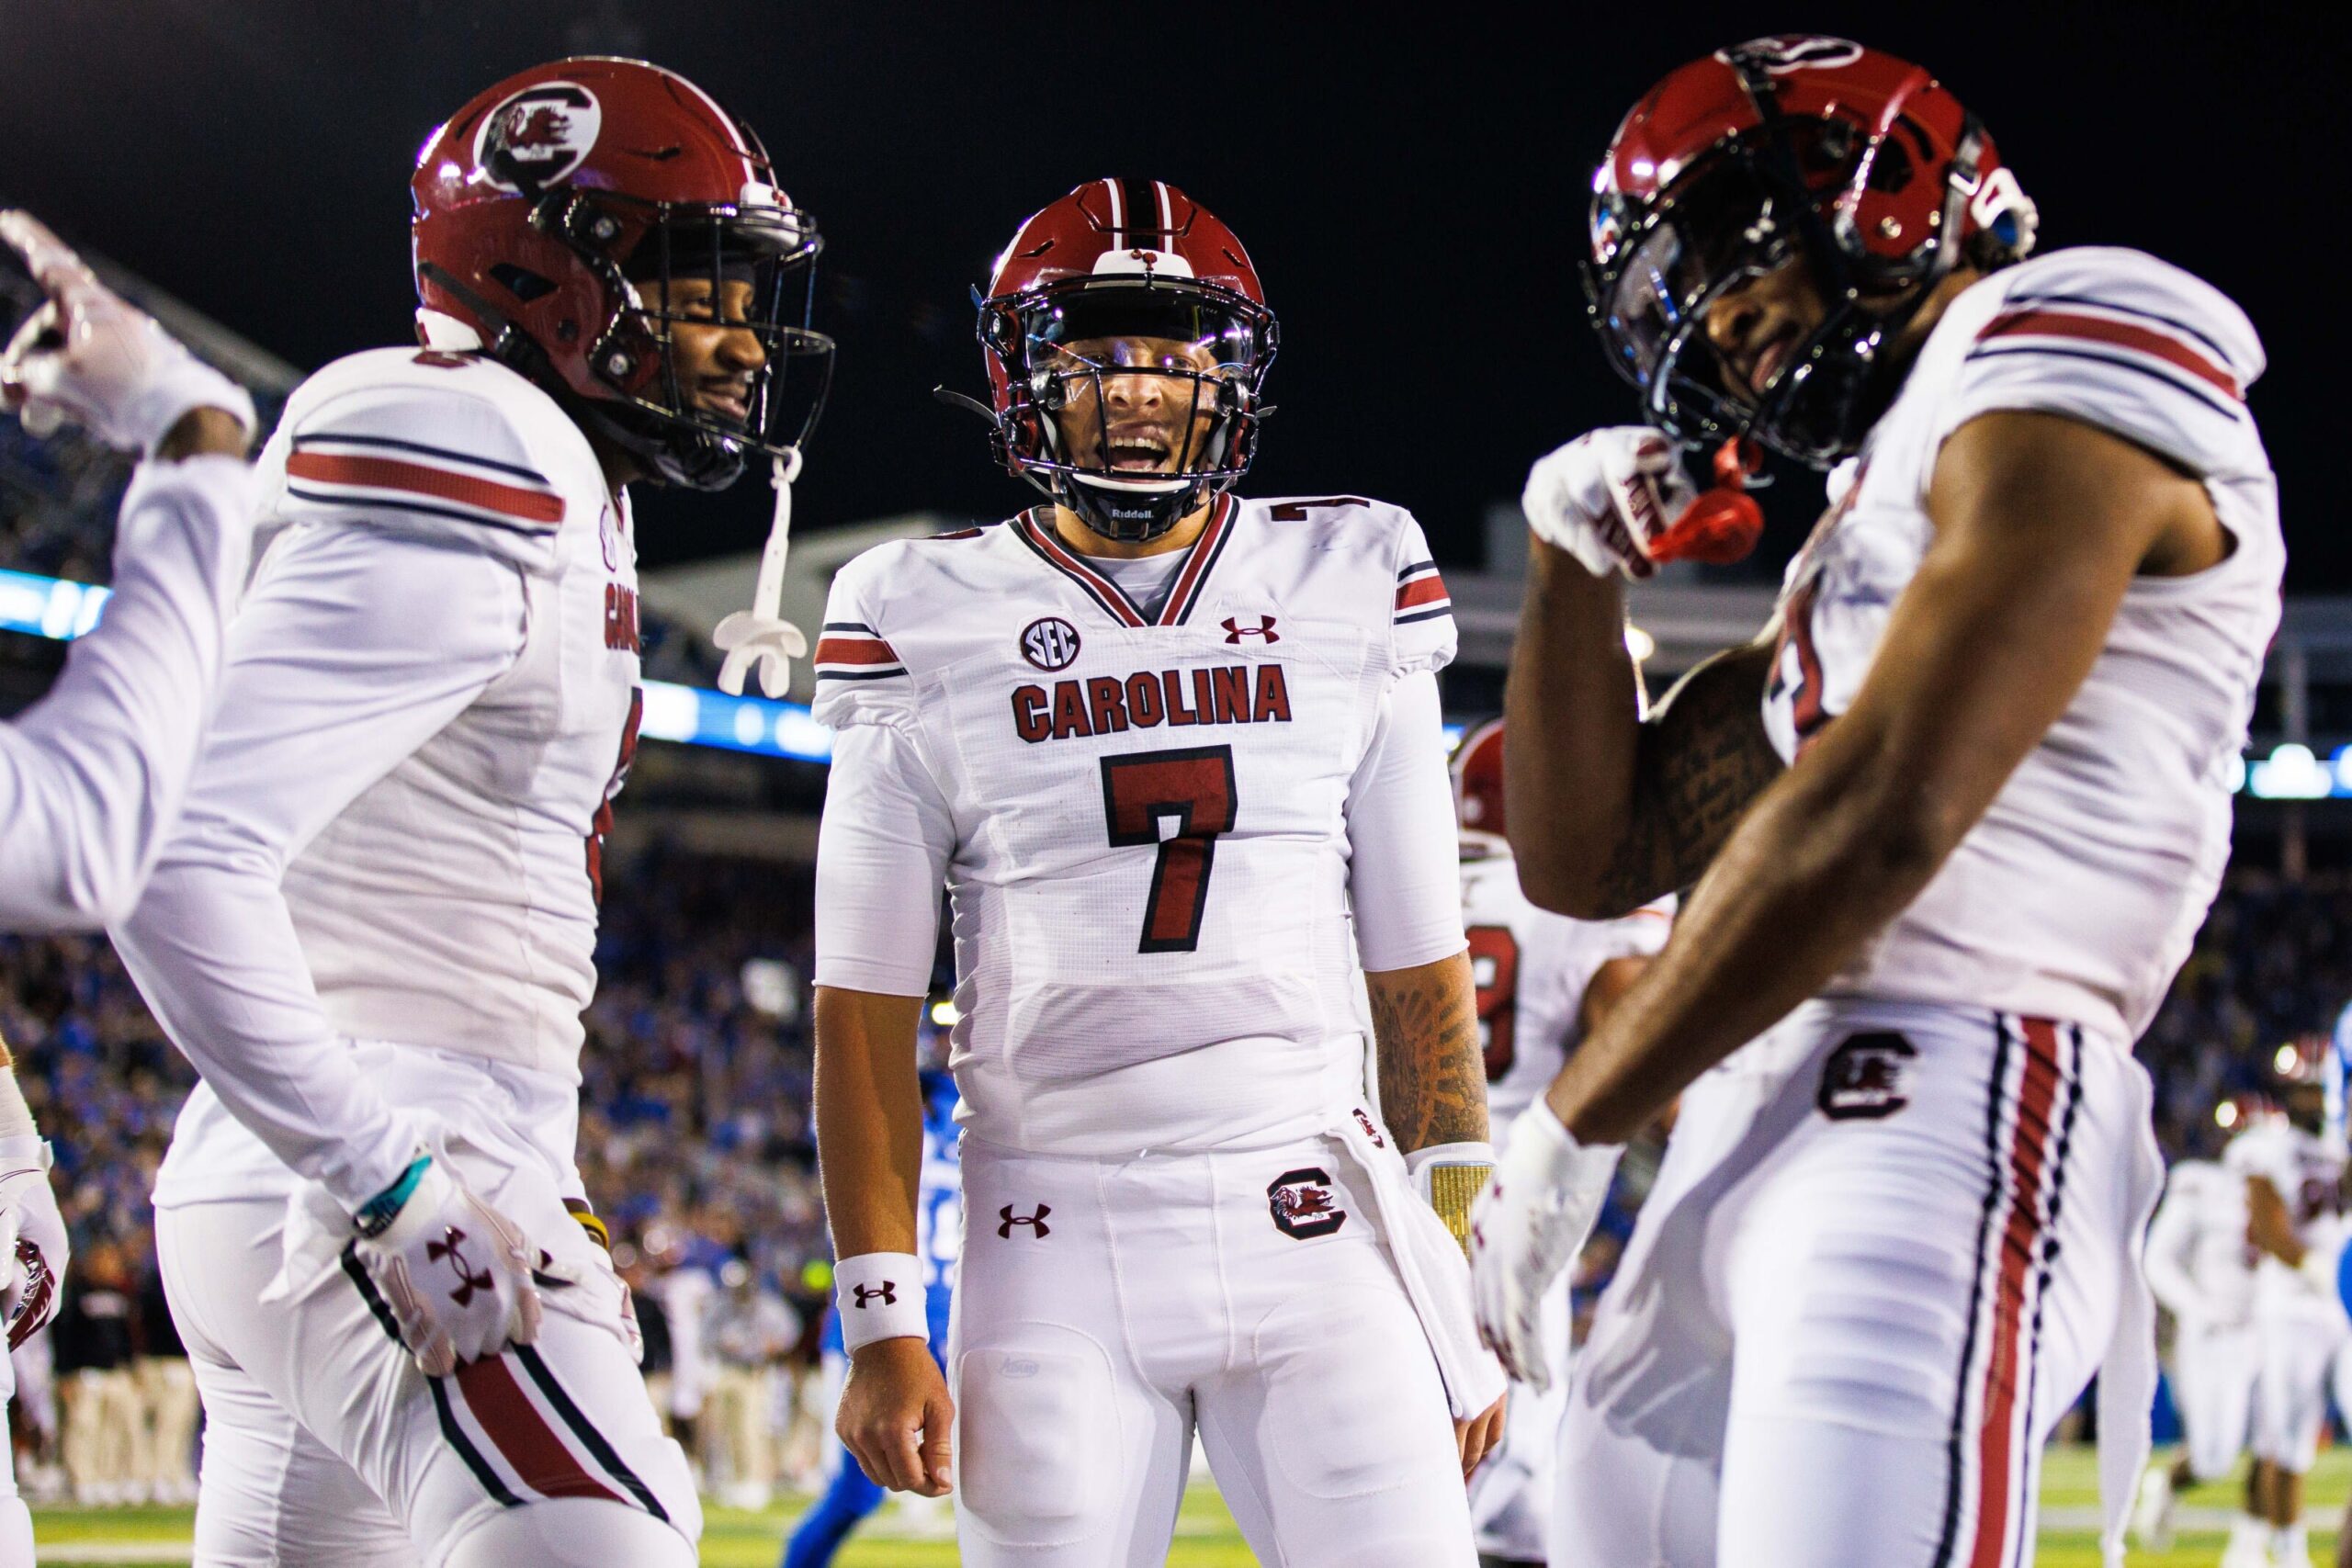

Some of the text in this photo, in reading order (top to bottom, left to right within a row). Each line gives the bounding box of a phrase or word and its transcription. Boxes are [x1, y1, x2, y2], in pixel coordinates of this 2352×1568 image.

[1112, 509, 1152, 519] Riddell
[1024, 620, 1077, 668] SEC
[1011, 664, 1292, 743] CAROLINA
[1100, 744, 1238, 953] 7
